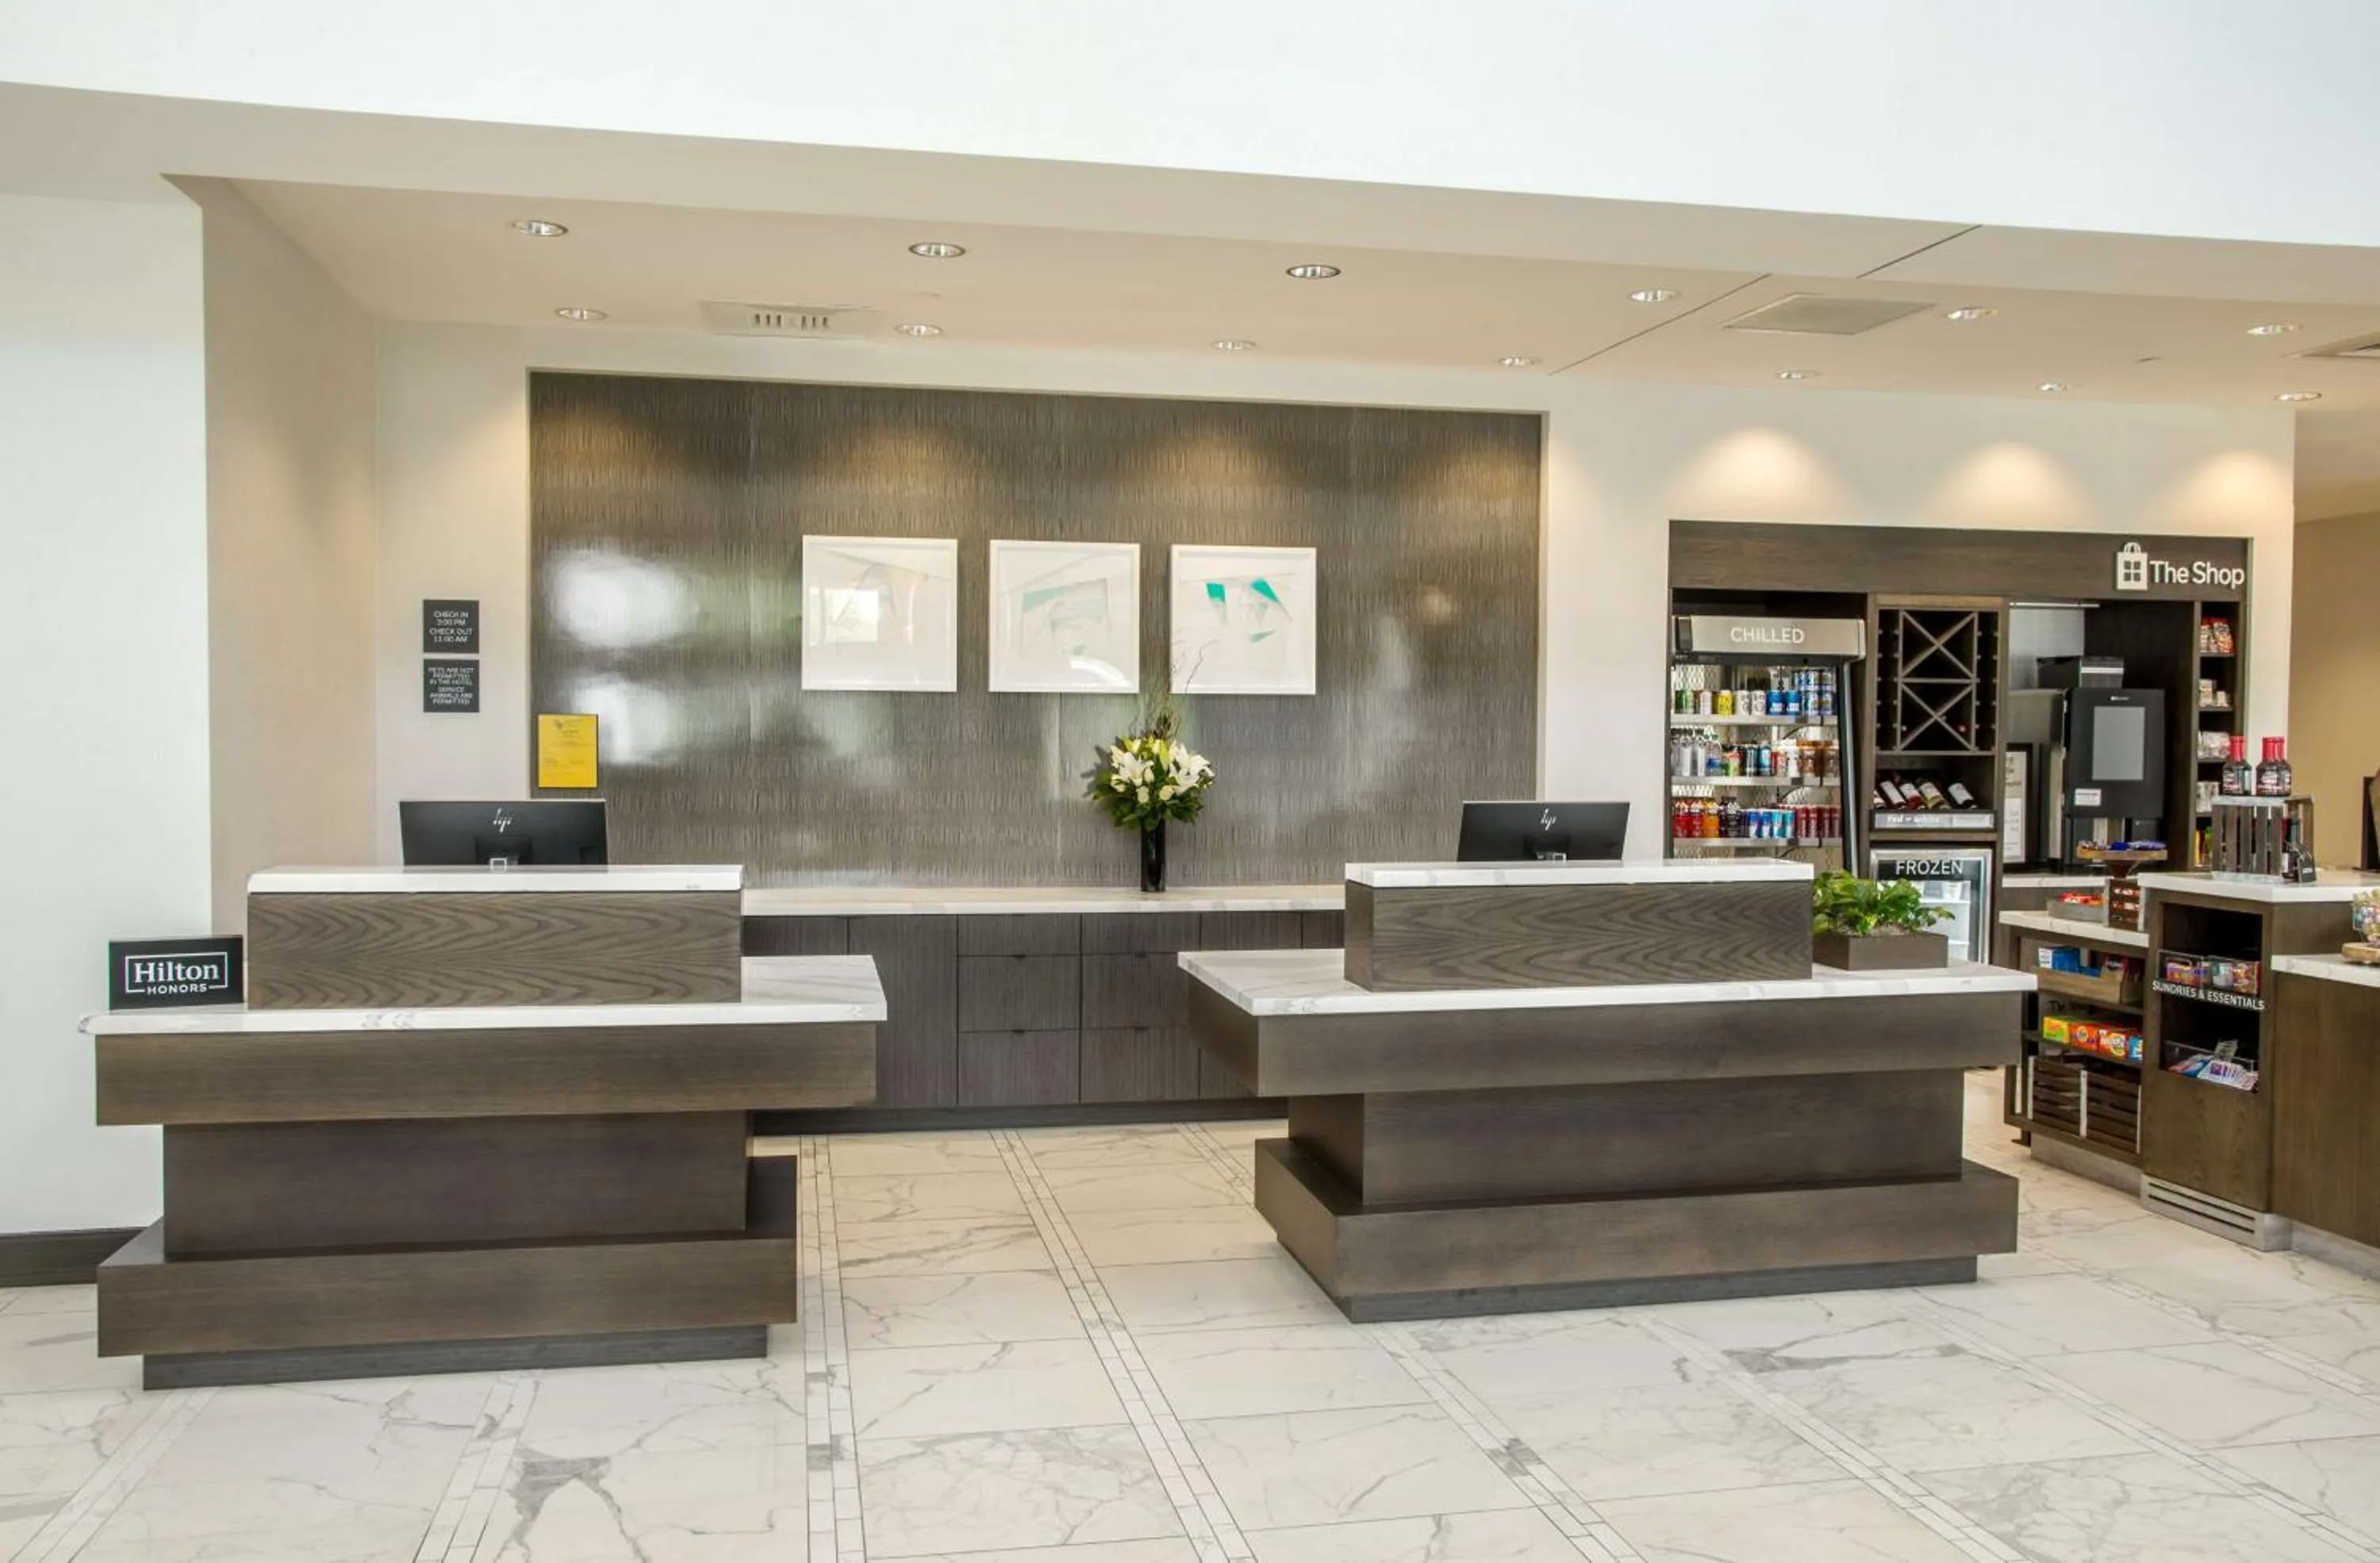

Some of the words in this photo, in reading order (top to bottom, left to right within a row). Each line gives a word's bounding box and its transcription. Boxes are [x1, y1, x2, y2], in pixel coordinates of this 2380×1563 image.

[2149, 559, 2190, 584] The
[2192, 561, 2245, 589] Shop
[1730, 626, 1806, 643] CHILLED
[1895, 859, 1964, 875] FROZEN
[134, 961, 220, 983] Hilton
[147, 983, 207, 995] HONORS
[2152, 980, 2197, 998] SUNDRIES
[2207, 991, 2266, 1011] ESSENTIALS
